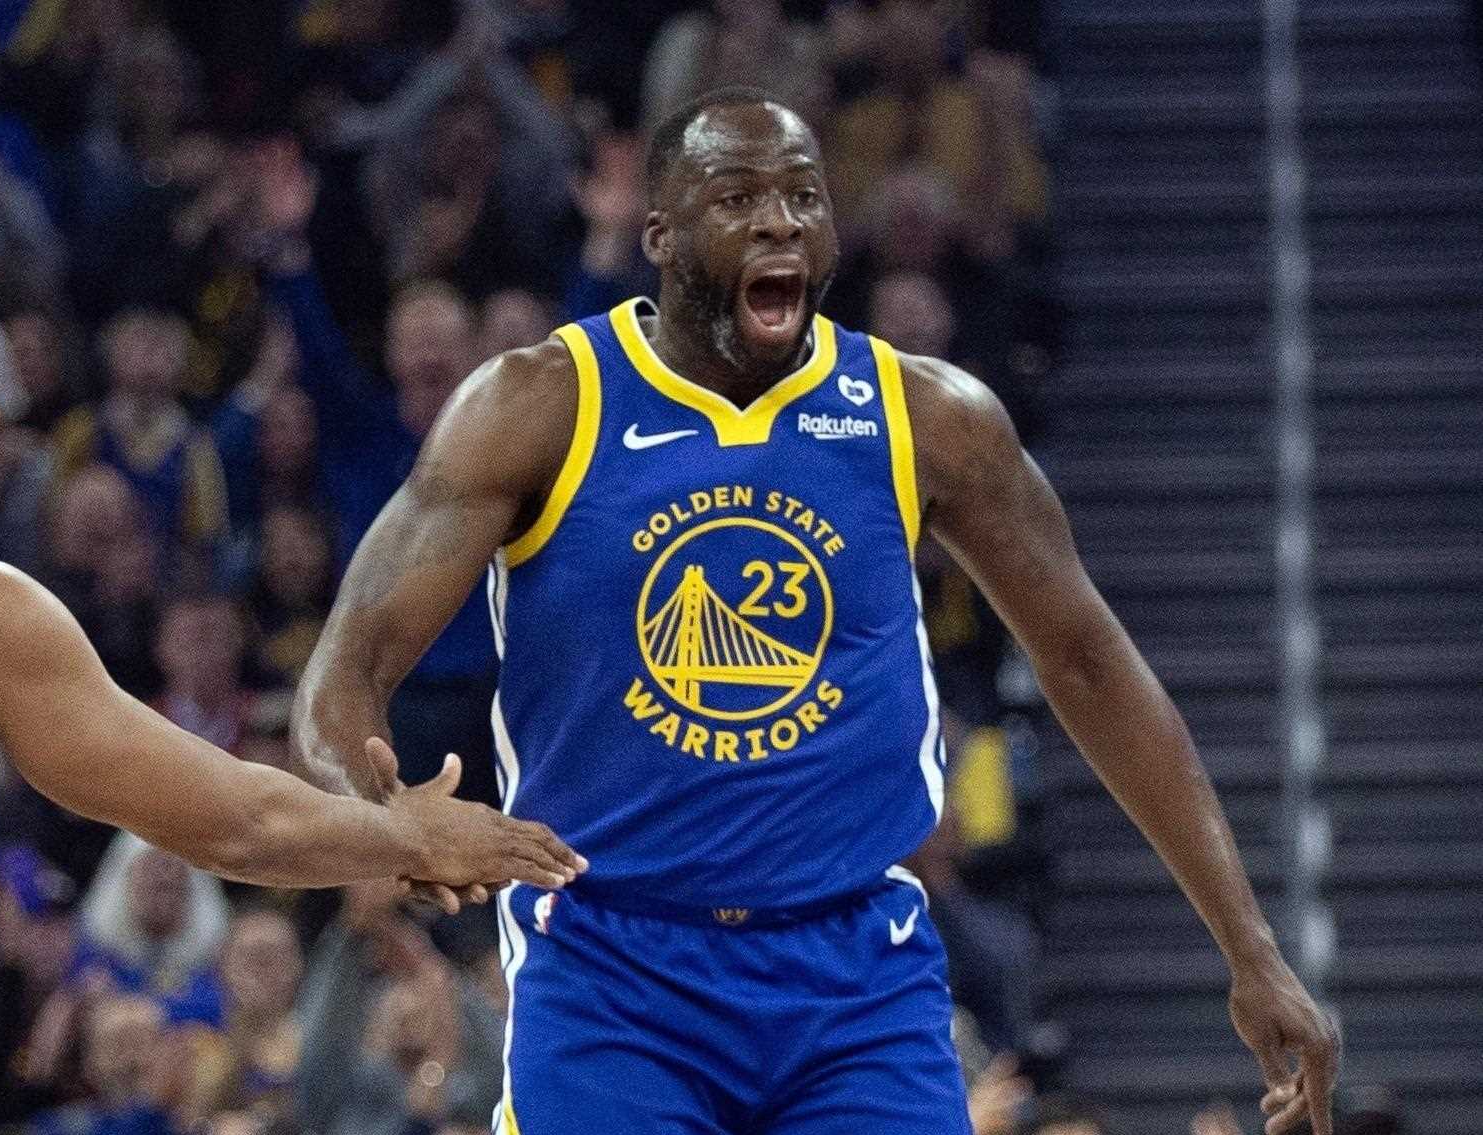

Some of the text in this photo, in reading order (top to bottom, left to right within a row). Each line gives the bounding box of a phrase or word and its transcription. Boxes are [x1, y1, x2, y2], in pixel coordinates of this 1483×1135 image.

[798, 413, 878, 439] Rakuten
[632, 486, 846, 557] GOLDEN STATE
[738, 560, 810, 618] 23
[623, 677, 846, 764] WARRIORS
